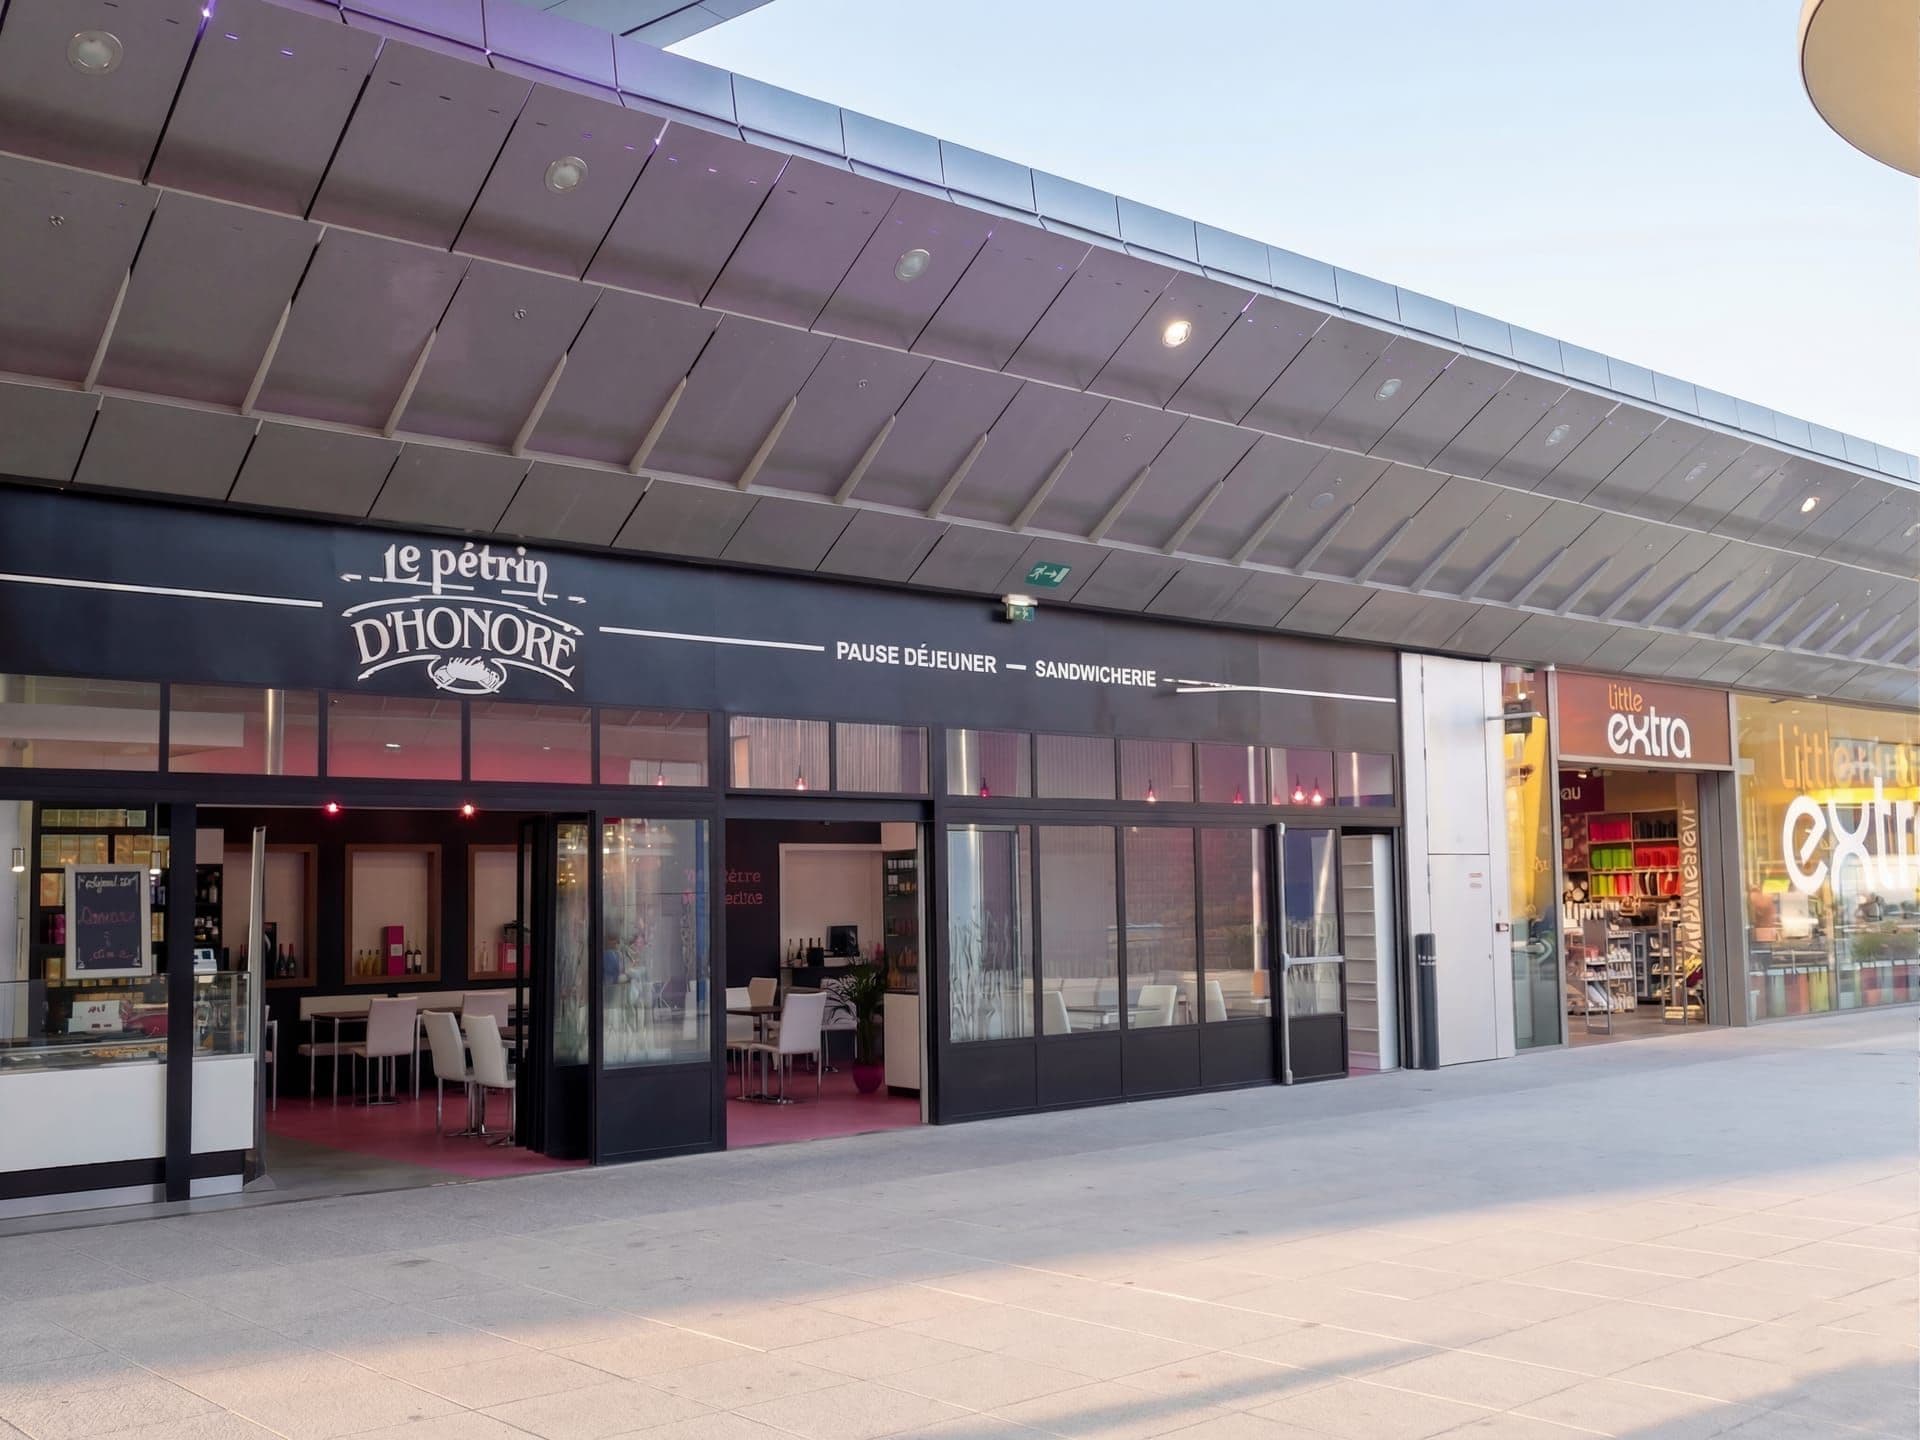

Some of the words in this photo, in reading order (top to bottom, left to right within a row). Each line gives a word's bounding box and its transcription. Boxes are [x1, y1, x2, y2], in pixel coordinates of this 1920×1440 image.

[384, 543, 421, 583] Le
[430, 542, 548, 606] pétrin
[836, 640, 899, 666] PAUSE
[904, 643, 998, 674] DÉJEUNER
[1034, 659, 1157, 688] SANDWICHERIE
[1607, 683, 1643, 712] little
[1607, 706, 1691, 759] extra
[1782, 775, 1920, 898] extr
